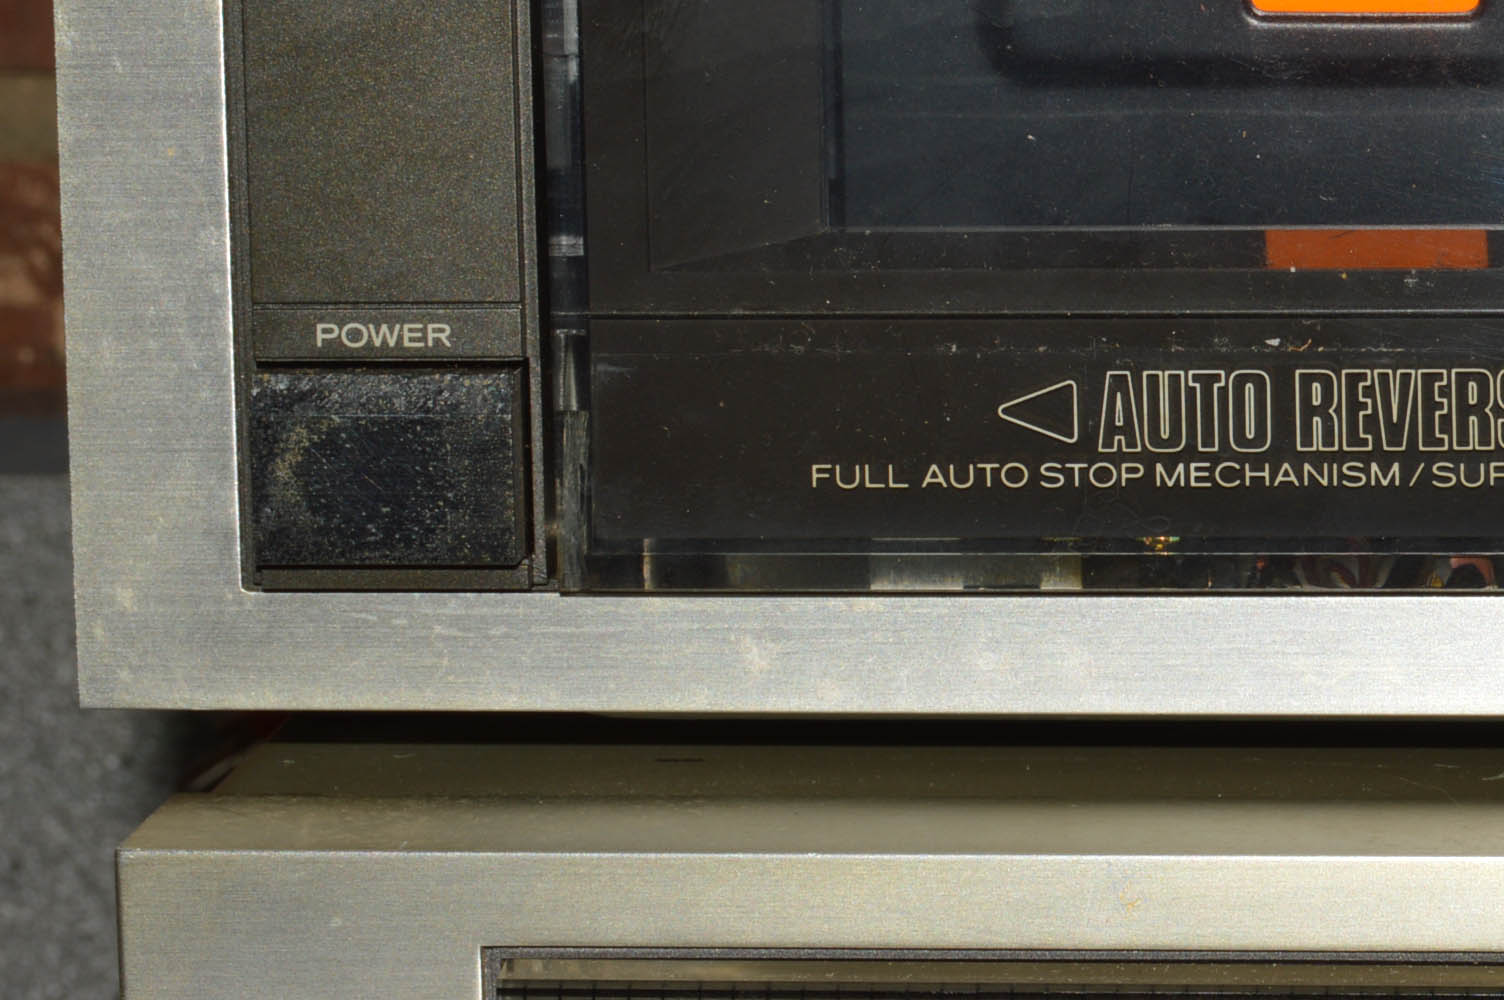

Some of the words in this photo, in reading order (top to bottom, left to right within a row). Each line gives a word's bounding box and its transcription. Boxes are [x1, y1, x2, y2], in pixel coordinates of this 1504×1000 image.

[315, 322, 452, 348] POWER
[1098, 370, 1267, 452] AUTO
[811, 463, 909, 489] FULL
[921, 462, 1029, 489] AUTO
[1040, 462, 1145, 488] STOP
